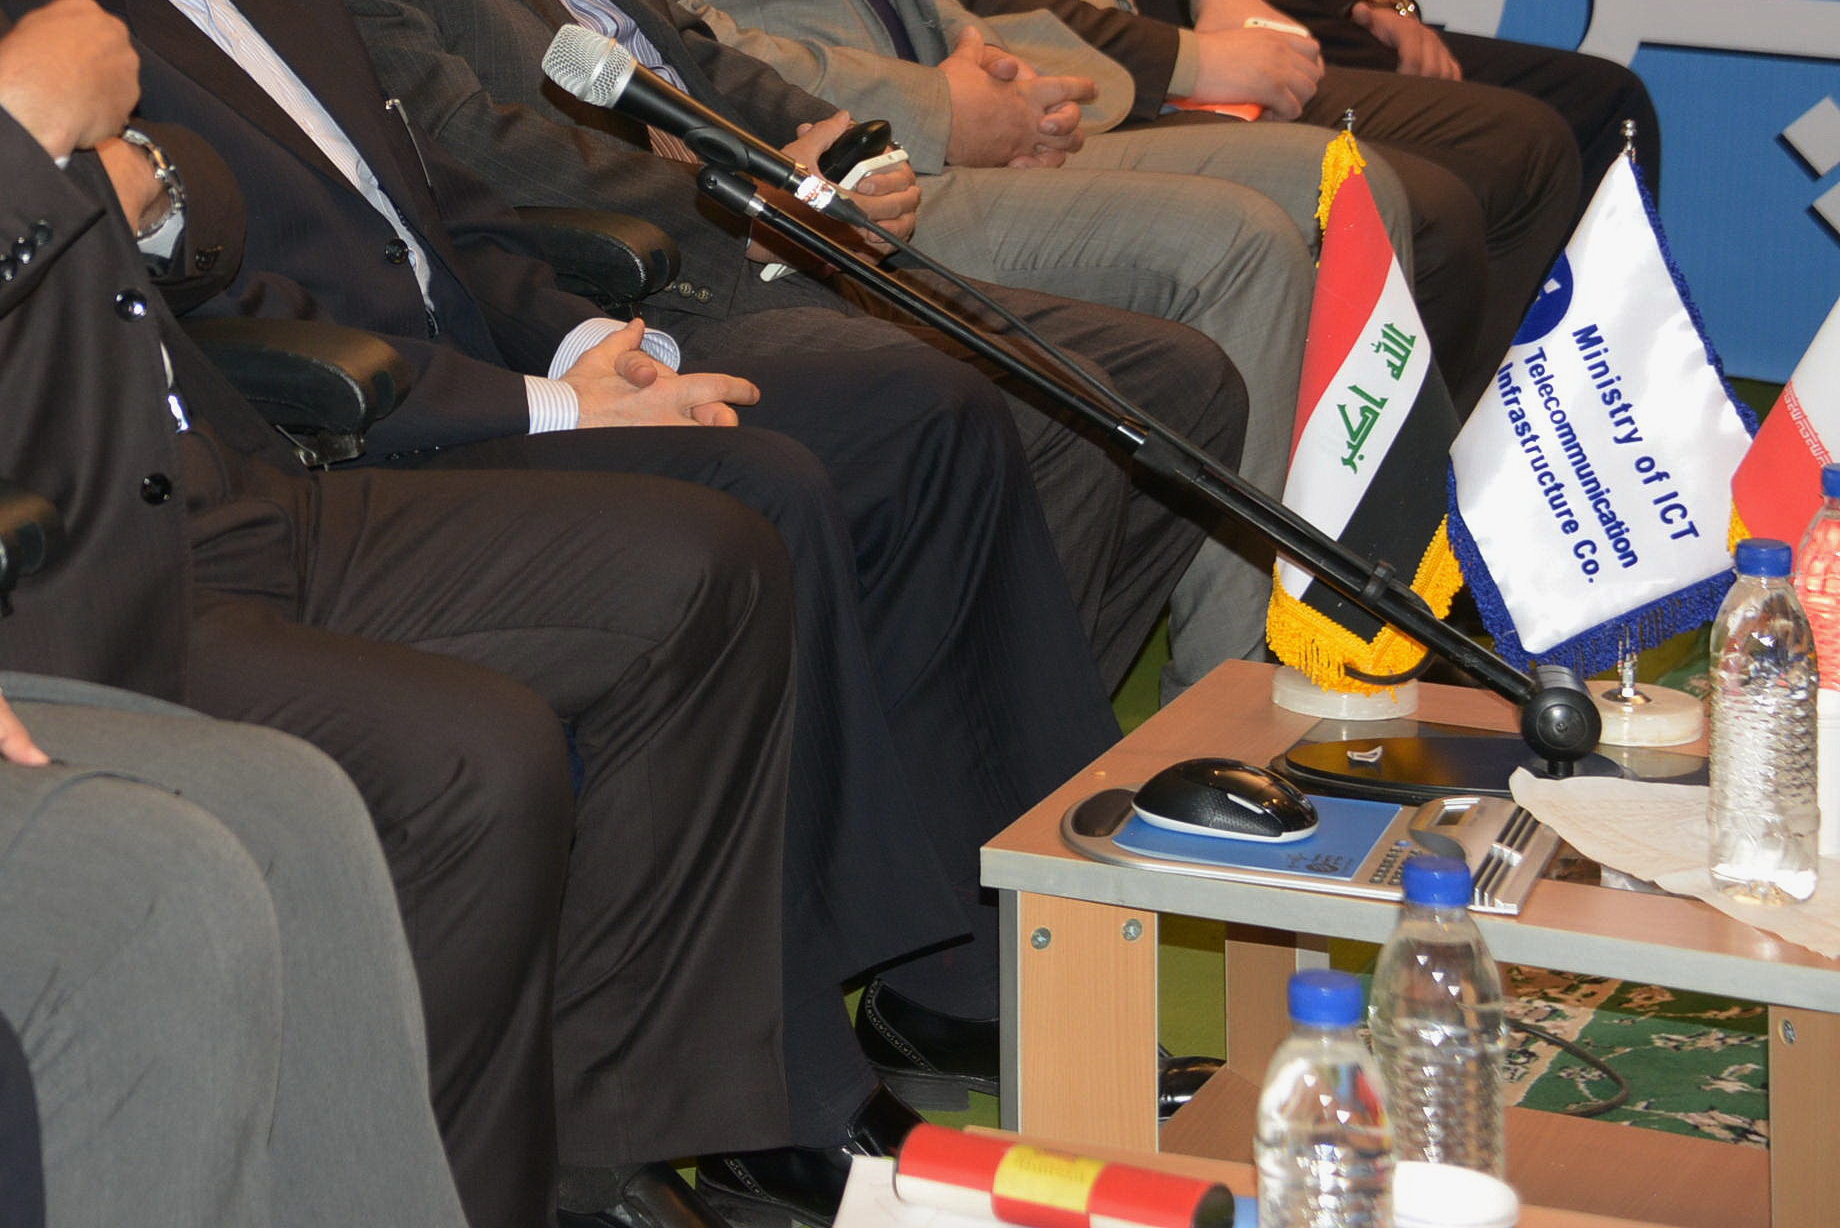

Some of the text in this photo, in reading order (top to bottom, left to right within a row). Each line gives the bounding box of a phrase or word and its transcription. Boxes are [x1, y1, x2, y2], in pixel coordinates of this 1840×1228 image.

[1497, 361, 1600, 583] Infrastructure Co.
[1523, 346, 1639, 569] Telecommunication
[1572, 323, 1700, 541] Ministry of ICT
